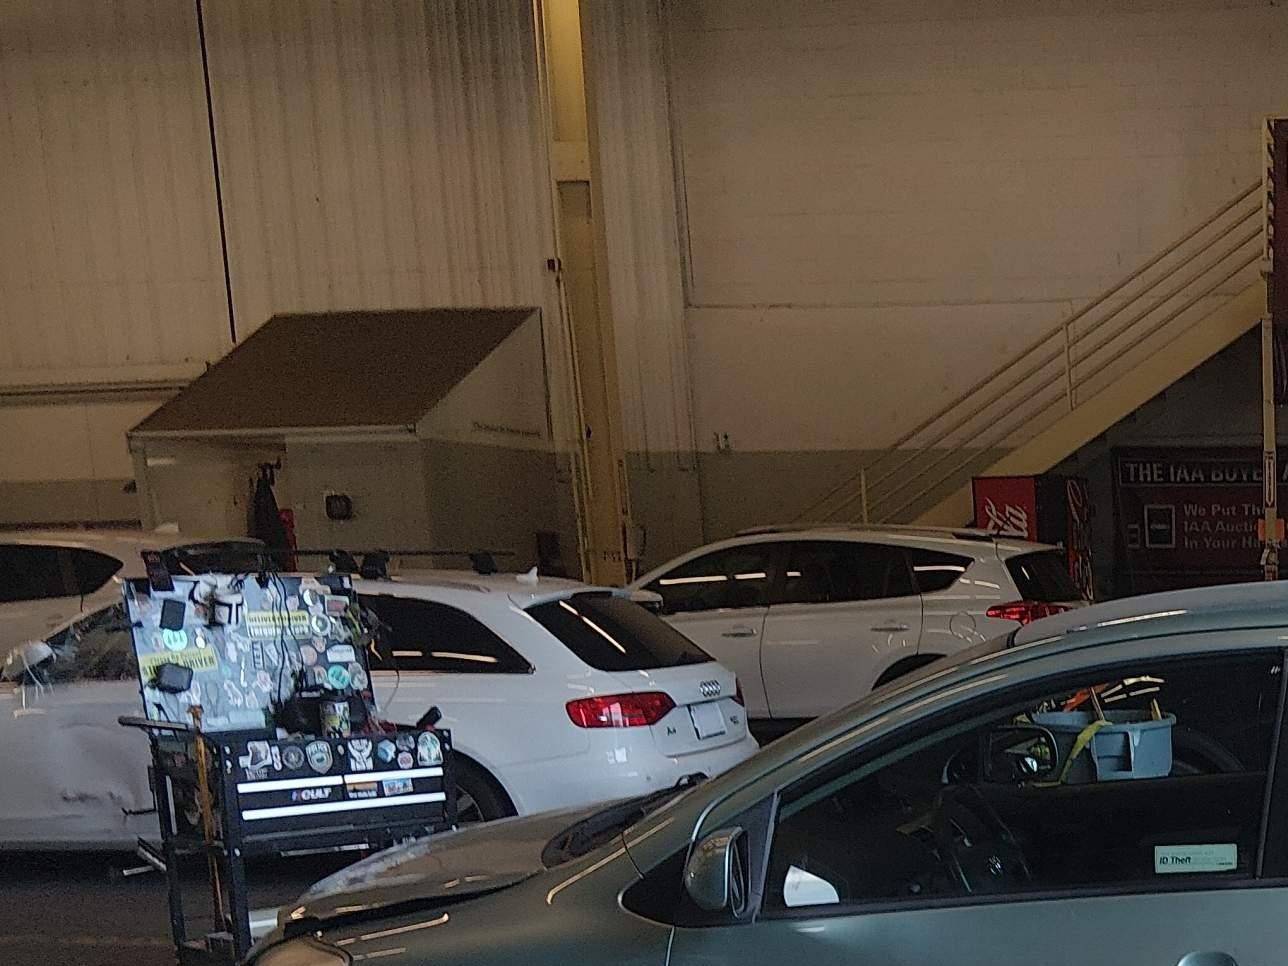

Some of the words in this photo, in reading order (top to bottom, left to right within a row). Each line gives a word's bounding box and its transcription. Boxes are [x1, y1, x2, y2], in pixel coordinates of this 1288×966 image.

[1126, 463, 1165, 482] THE
[1170, 463, 1204, 482] IAA
[1211, 463, 1263, 482] BUYE
[1184, 503, 1207, 517] We
[1211, 503, 1237, 517] Put
[1242, 503, 1264, 517] Th
[1184, 520, 1212, 533] IAA
[1184, 536, 1199, 549] In
[1203, 536, 1236, 549] Your
[1171, 855, 1192, 865] Theft
